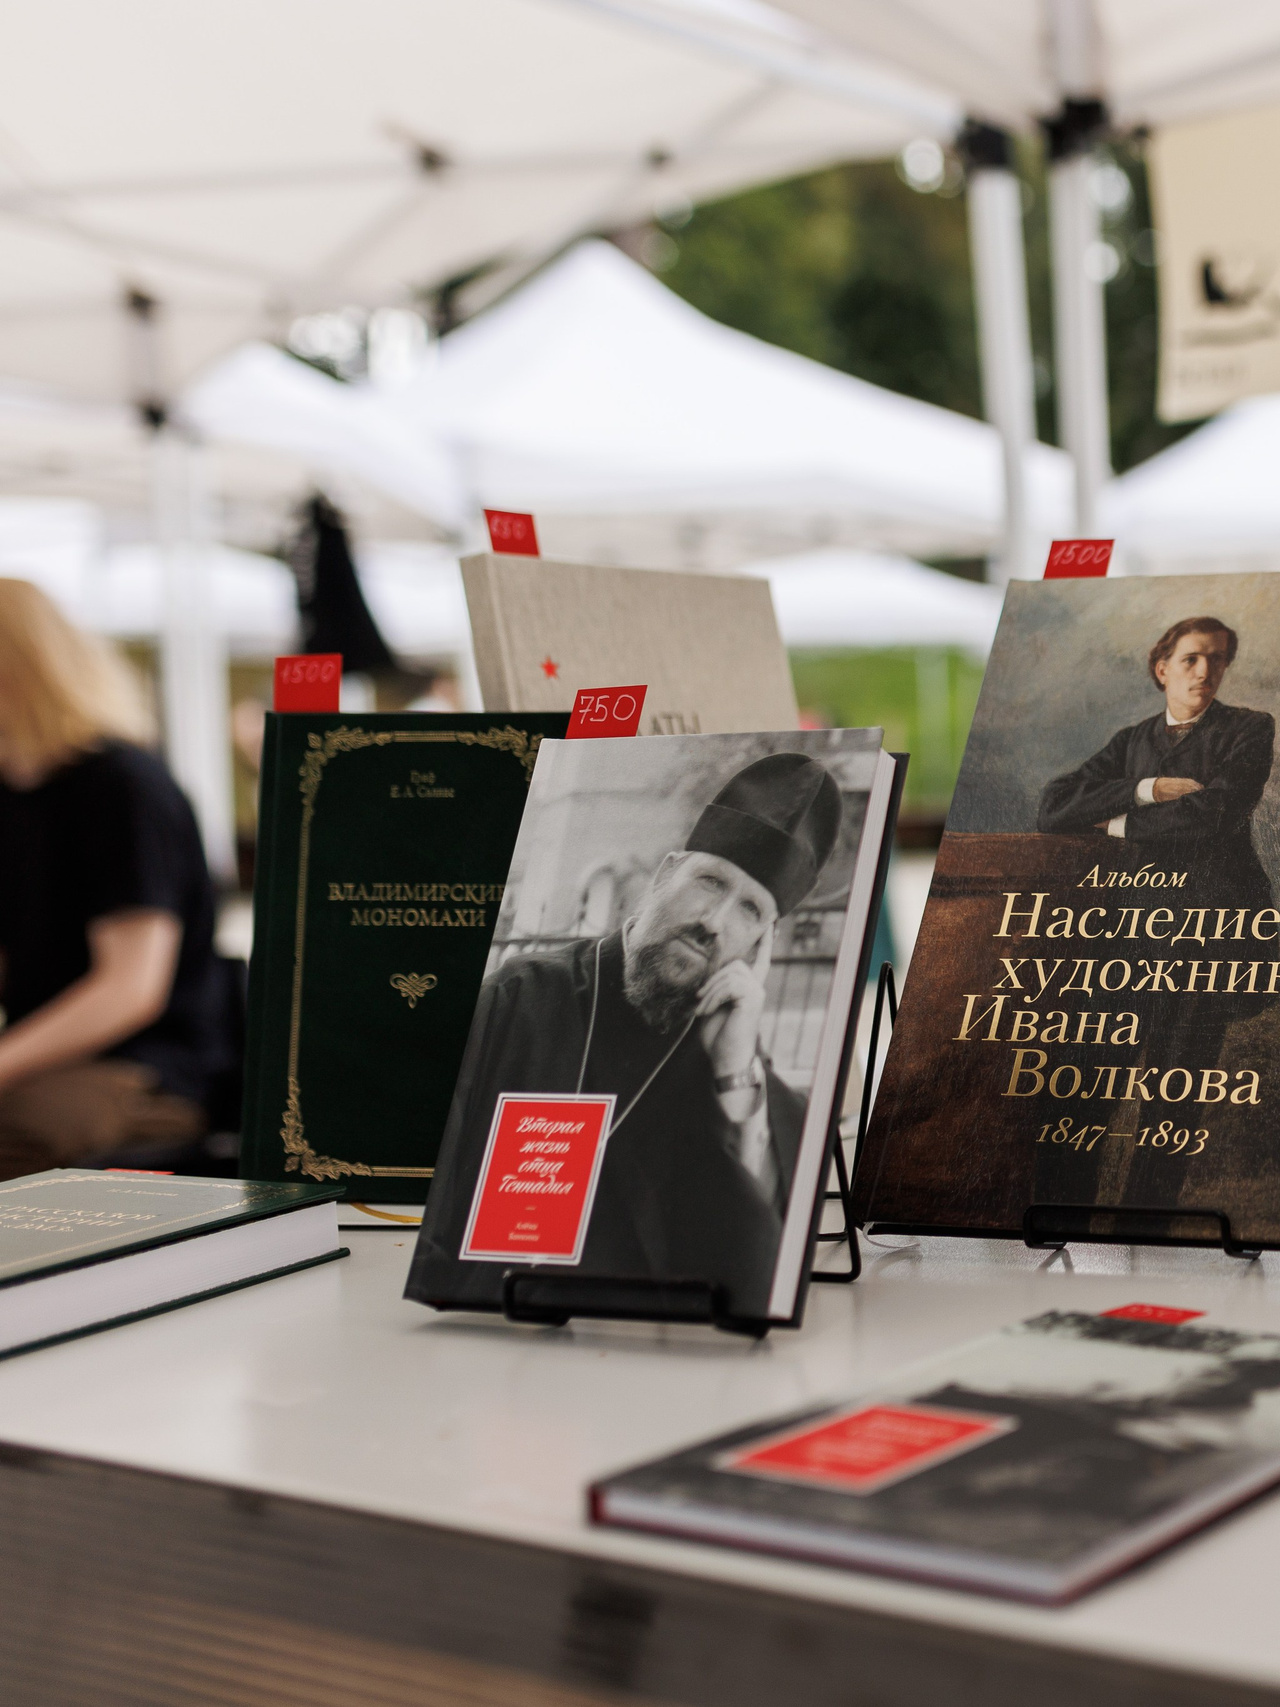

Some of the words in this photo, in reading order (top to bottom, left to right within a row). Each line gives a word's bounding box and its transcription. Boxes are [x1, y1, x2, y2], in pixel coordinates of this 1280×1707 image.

[1052, 541, 1112, 567] 1500
[578, 693, 637, 724] 750
[1077, 862, 1188, 888] Альбом
[351, 908, 487, 927] МОНОМАХИ
[992, 892, 1280, 947] Наследие
[952, 993, 1140, 1046] Ивана
[1000, 1047, 1262, 1105] Волкова
[515, 1115, 586, 1139] Вторая
[519, 1140, 571, 1154] жизнь
[517, 1156, 565, 1178] отца
[498, 1173, 575, 1195] Геннадия
